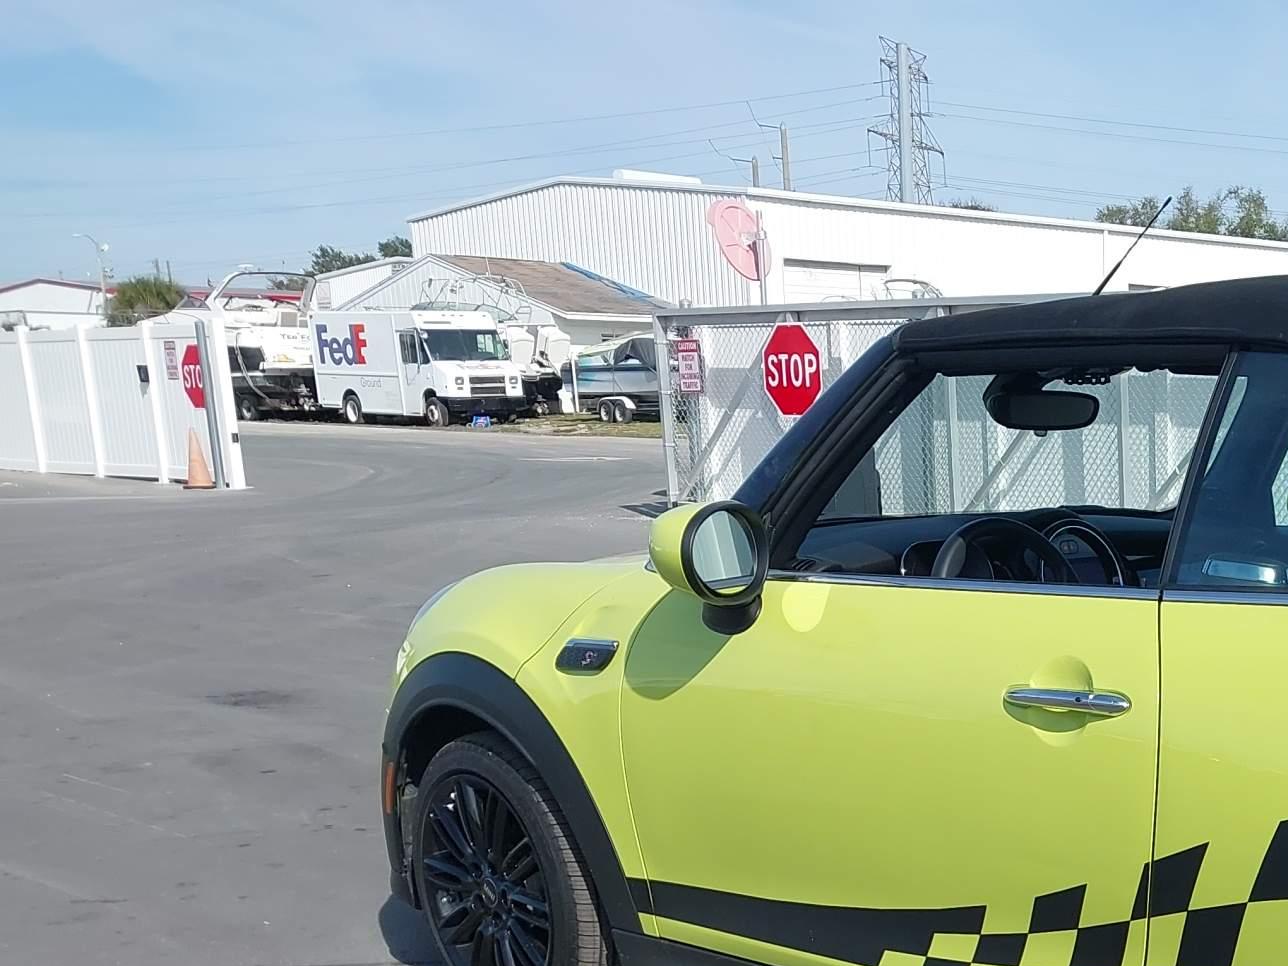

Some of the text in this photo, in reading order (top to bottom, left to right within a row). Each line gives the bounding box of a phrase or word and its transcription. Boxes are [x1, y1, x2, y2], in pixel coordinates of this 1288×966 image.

[678, 342, 697, 350] CAUTION
[184, 365, 203, 388] STO
[767, 353, 817, 387] STOP
[682, 381, 698, 389] TRAFFIC
